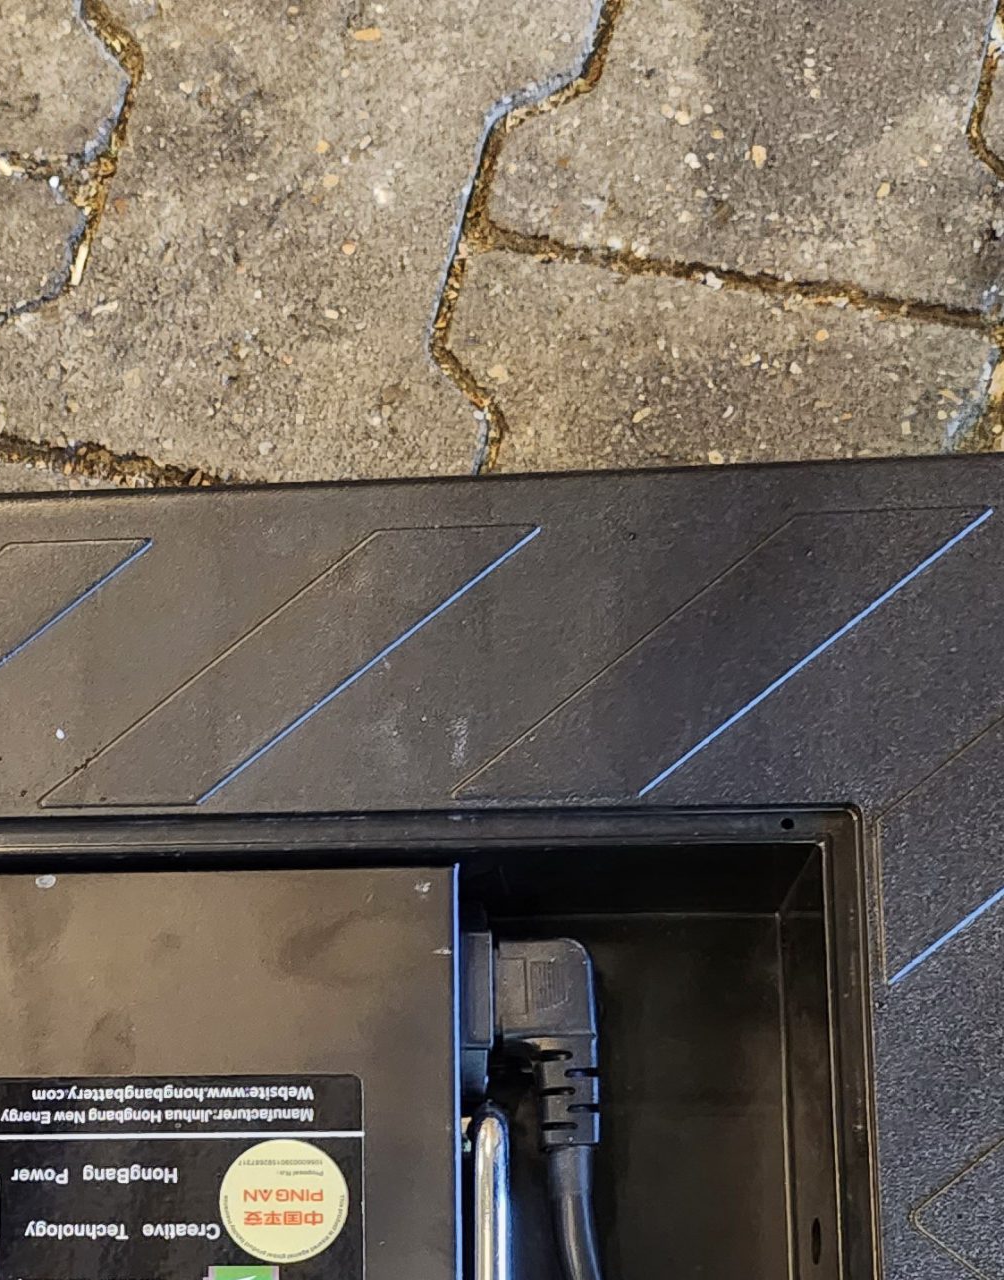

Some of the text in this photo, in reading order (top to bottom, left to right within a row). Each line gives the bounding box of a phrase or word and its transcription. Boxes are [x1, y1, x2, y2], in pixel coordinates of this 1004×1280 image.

[32, 1084, 314, 1102] Website:www.hongbangbattery.com
[1, 1109, 51, 1124] Energy
[54, 1111, 85, 1123] New
[89, 1107, 162, 1124] Hongbang
[165, 1108, 314, 1123] Manufacturer:Jinhua
[11, 1164, 178, 1185] HongBang Power
[244, 1211, 323, 1226] 中国平安
[25, 1220, 221, 1240] Creative Technology
